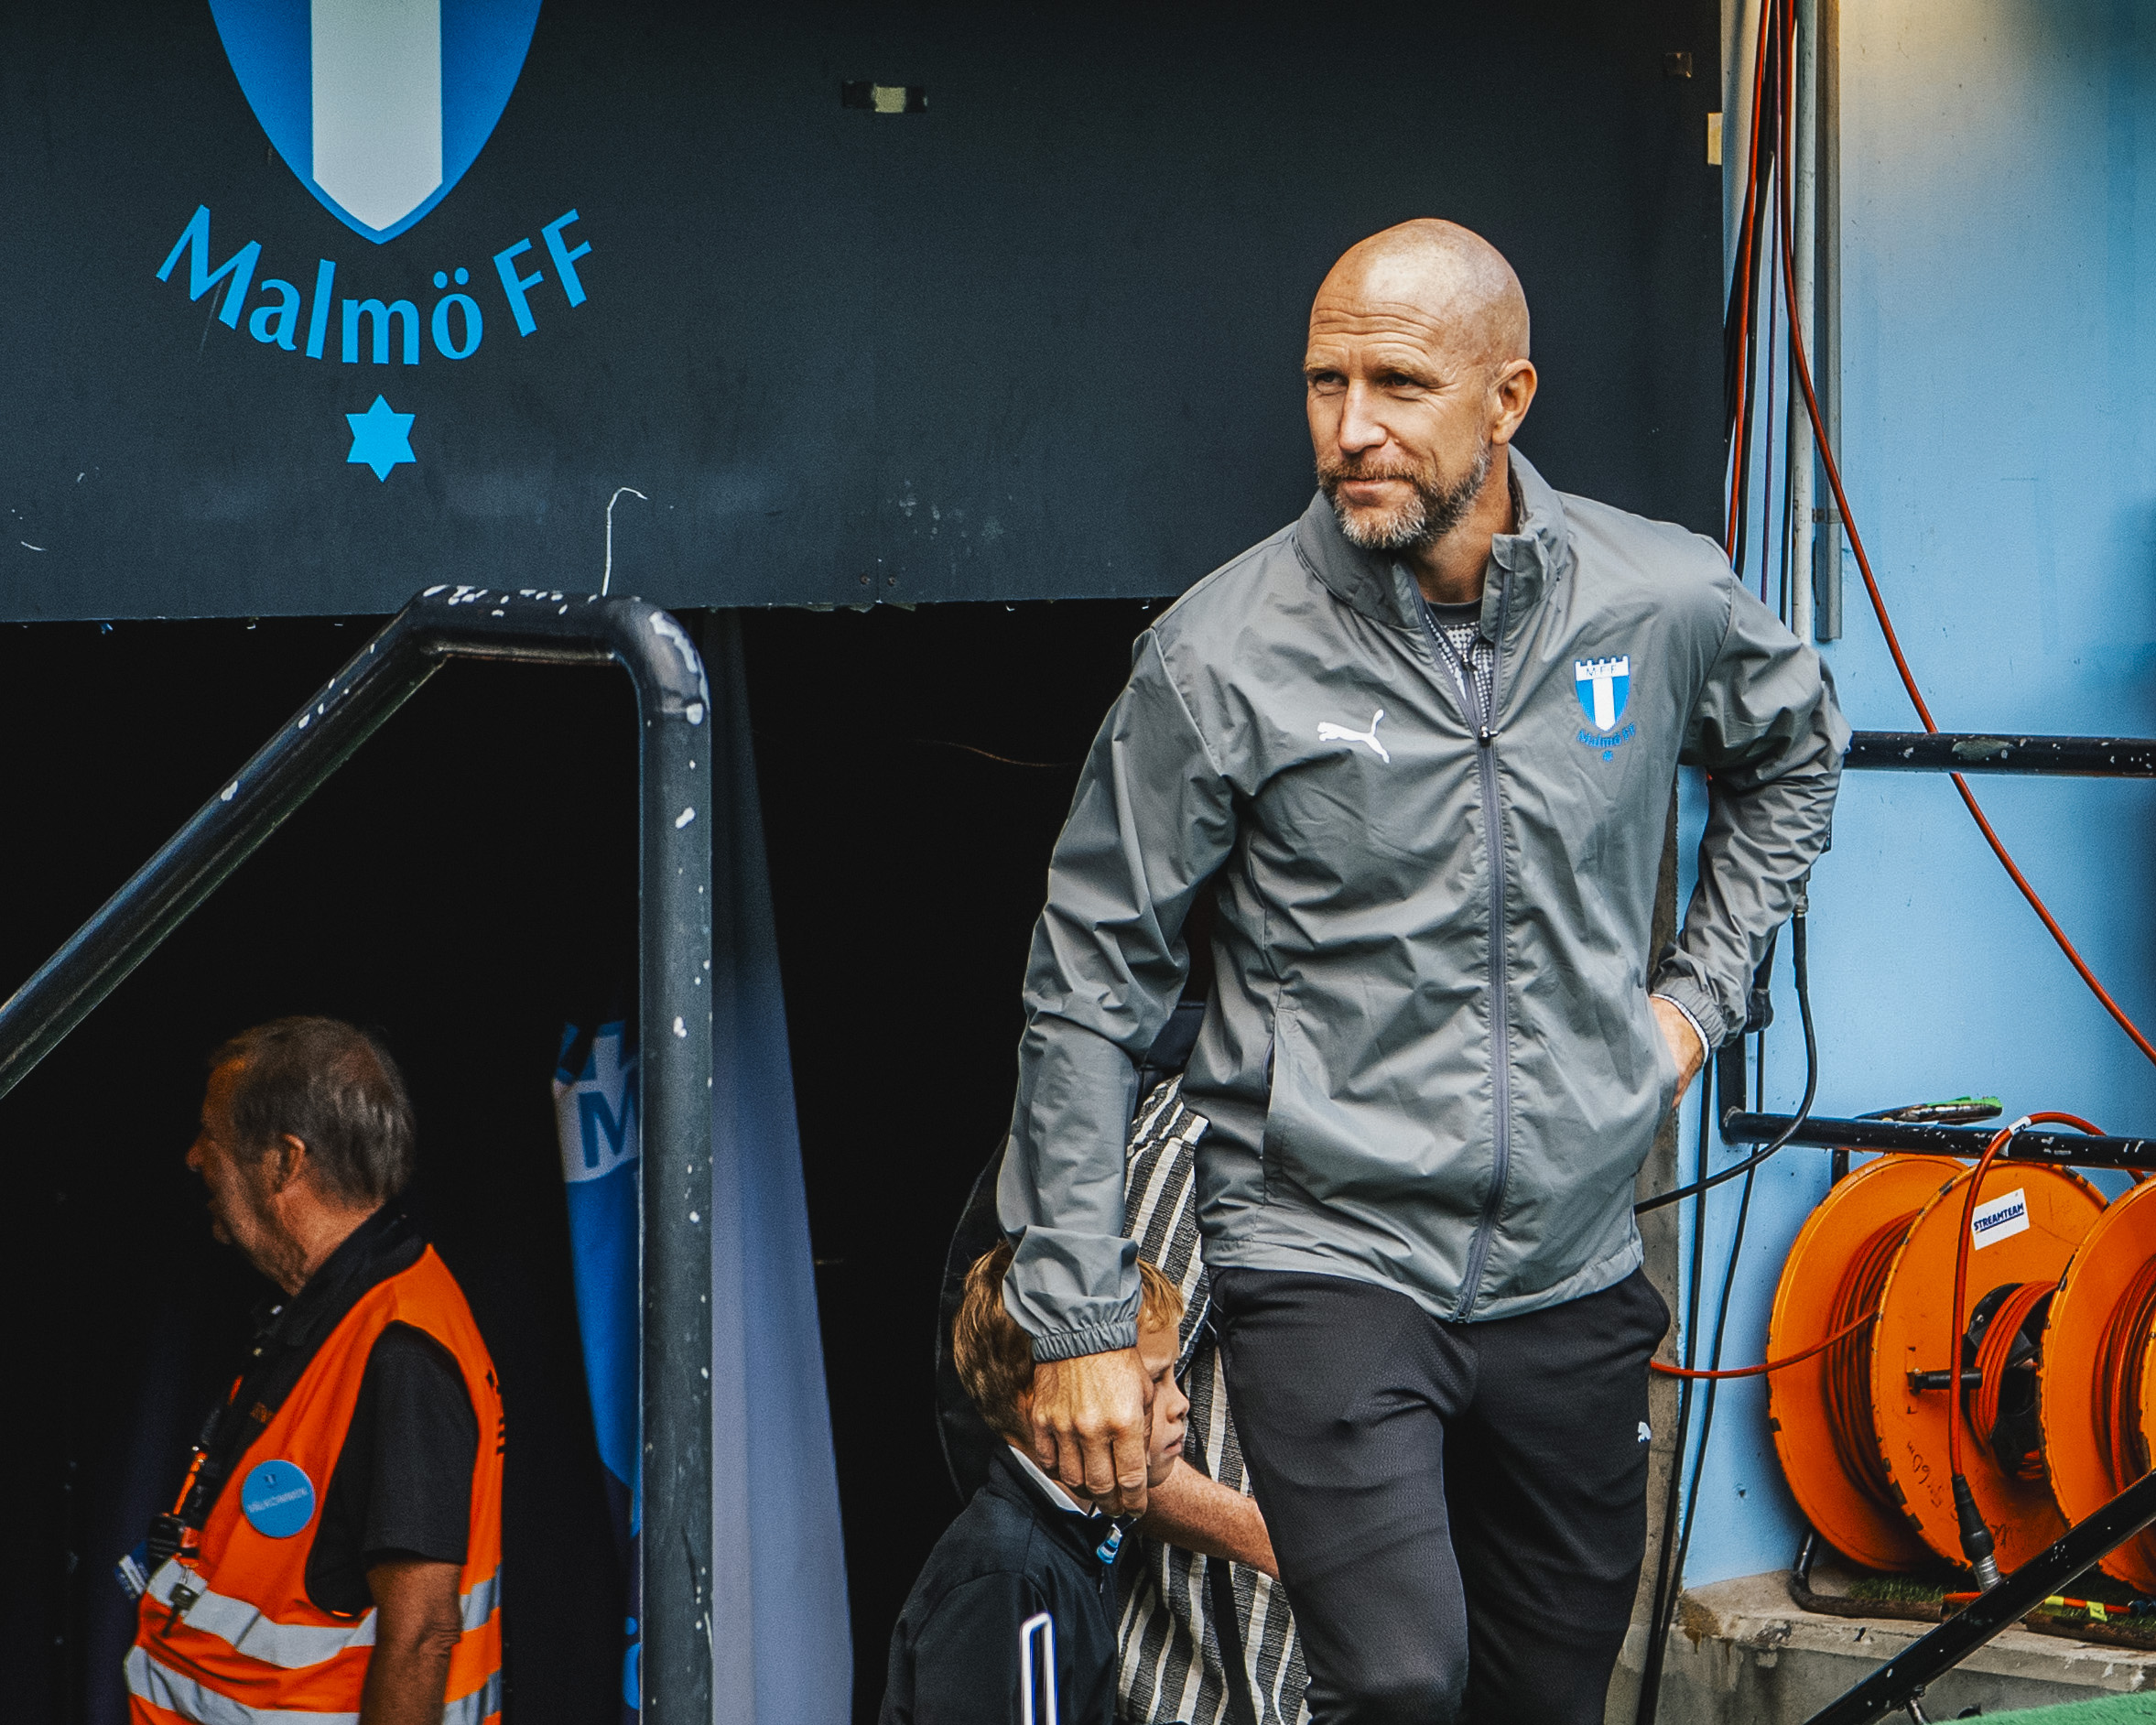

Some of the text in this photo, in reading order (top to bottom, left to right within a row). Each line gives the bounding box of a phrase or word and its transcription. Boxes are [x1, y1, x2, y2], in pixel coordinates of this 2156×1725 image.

[156, 204, 592, 365] Malmö FF
[1577, 730, 1621, 747] Malmö
[1973, 1202, 2024, 1231] STREAMTEAM
